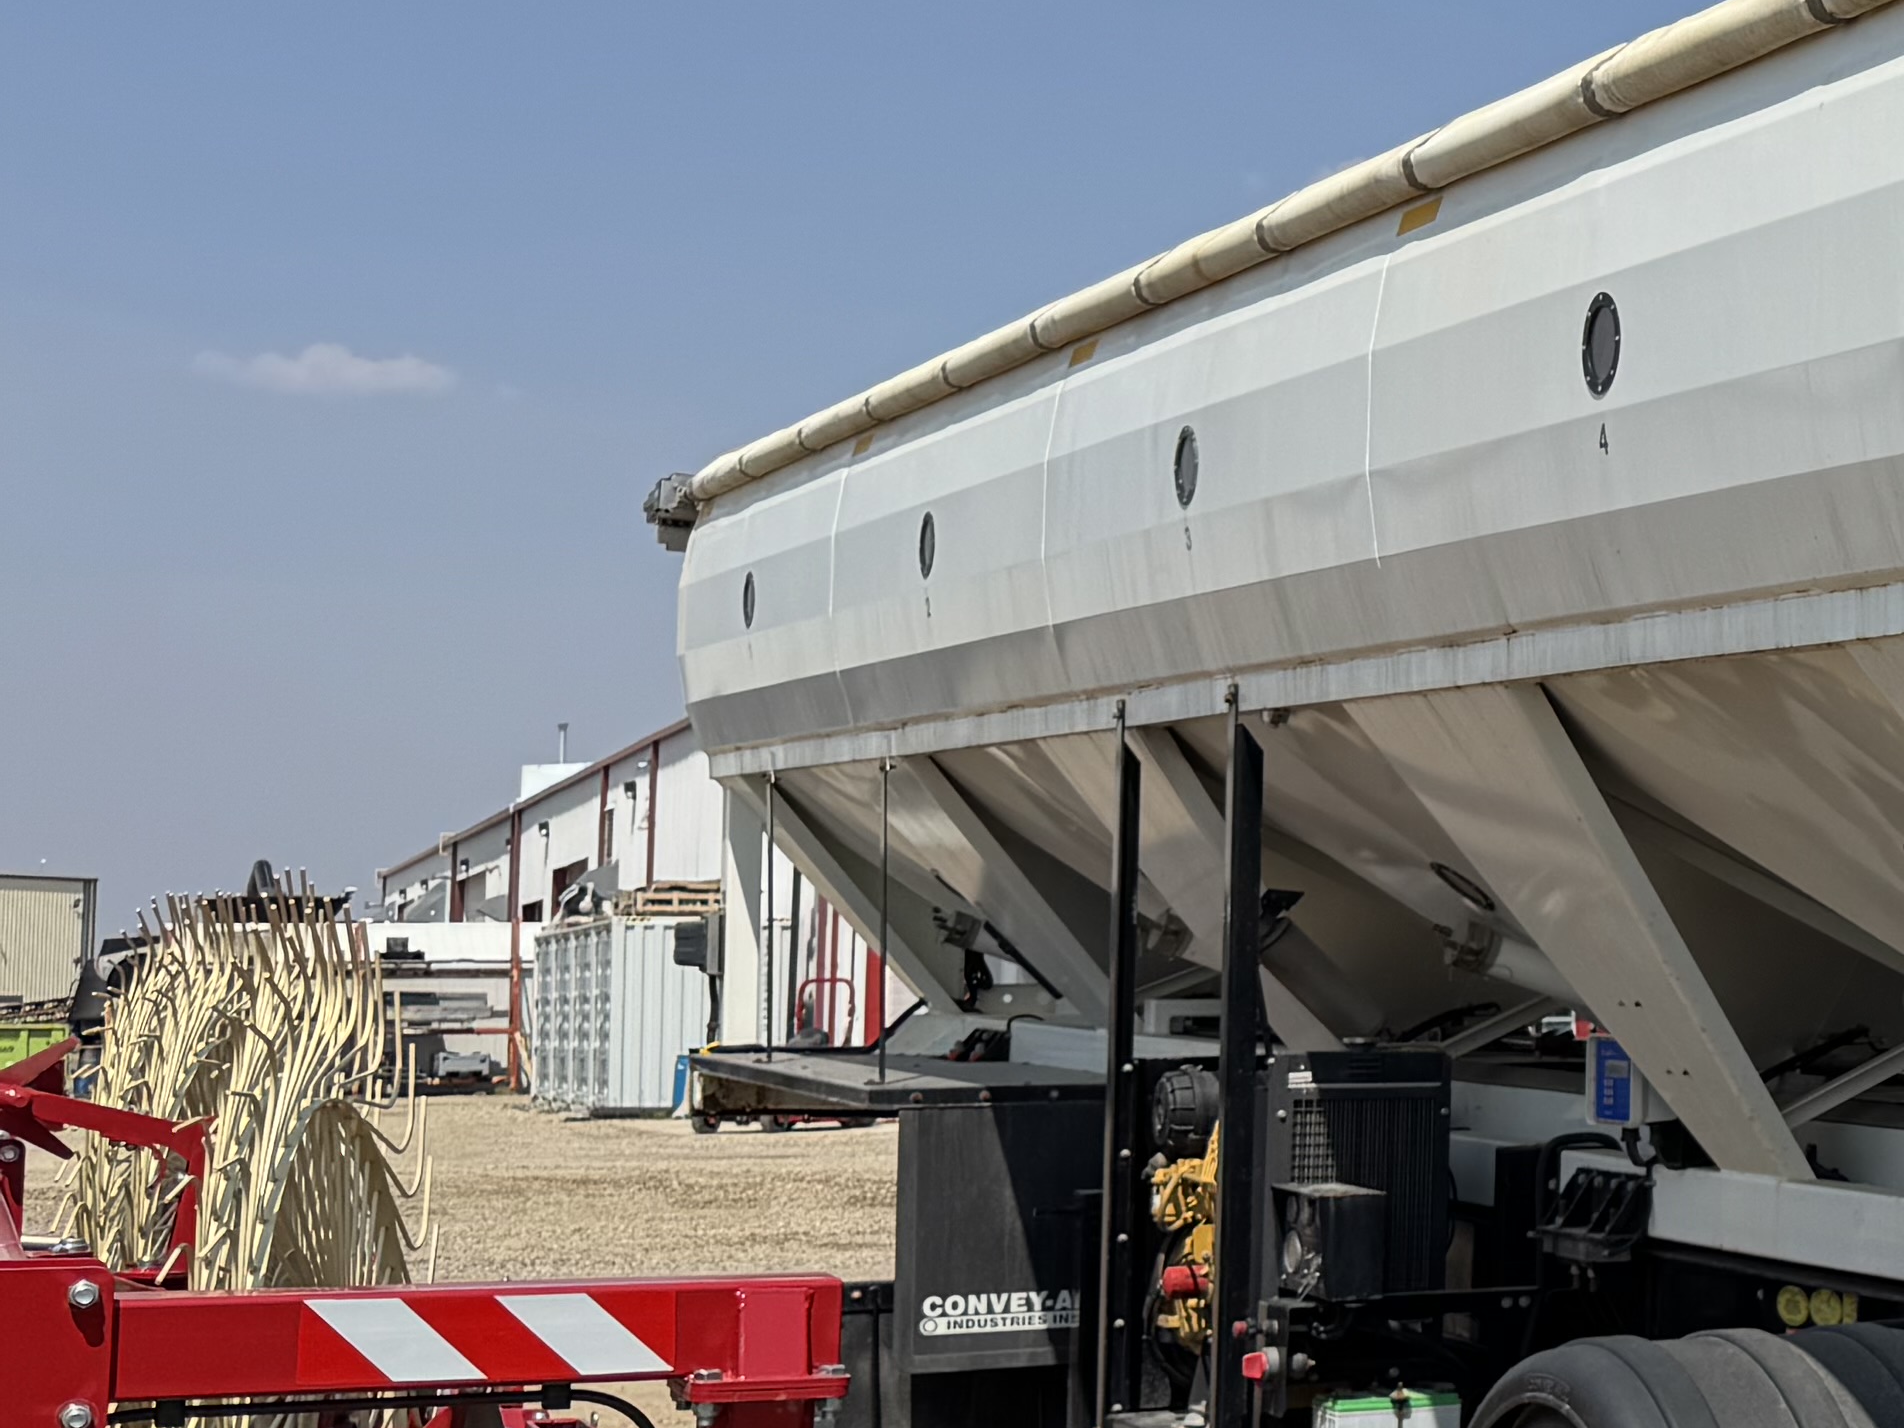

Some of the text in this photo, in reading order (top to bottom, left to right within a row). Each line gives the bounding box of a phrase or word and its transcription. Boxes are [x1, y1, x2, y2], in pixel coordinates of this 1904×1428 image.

[1599, 422, 1609, 456] 4
[1184, 525, 1193, 551] 3
[947, 1315, 1048, 1330] INDUSTRIES
